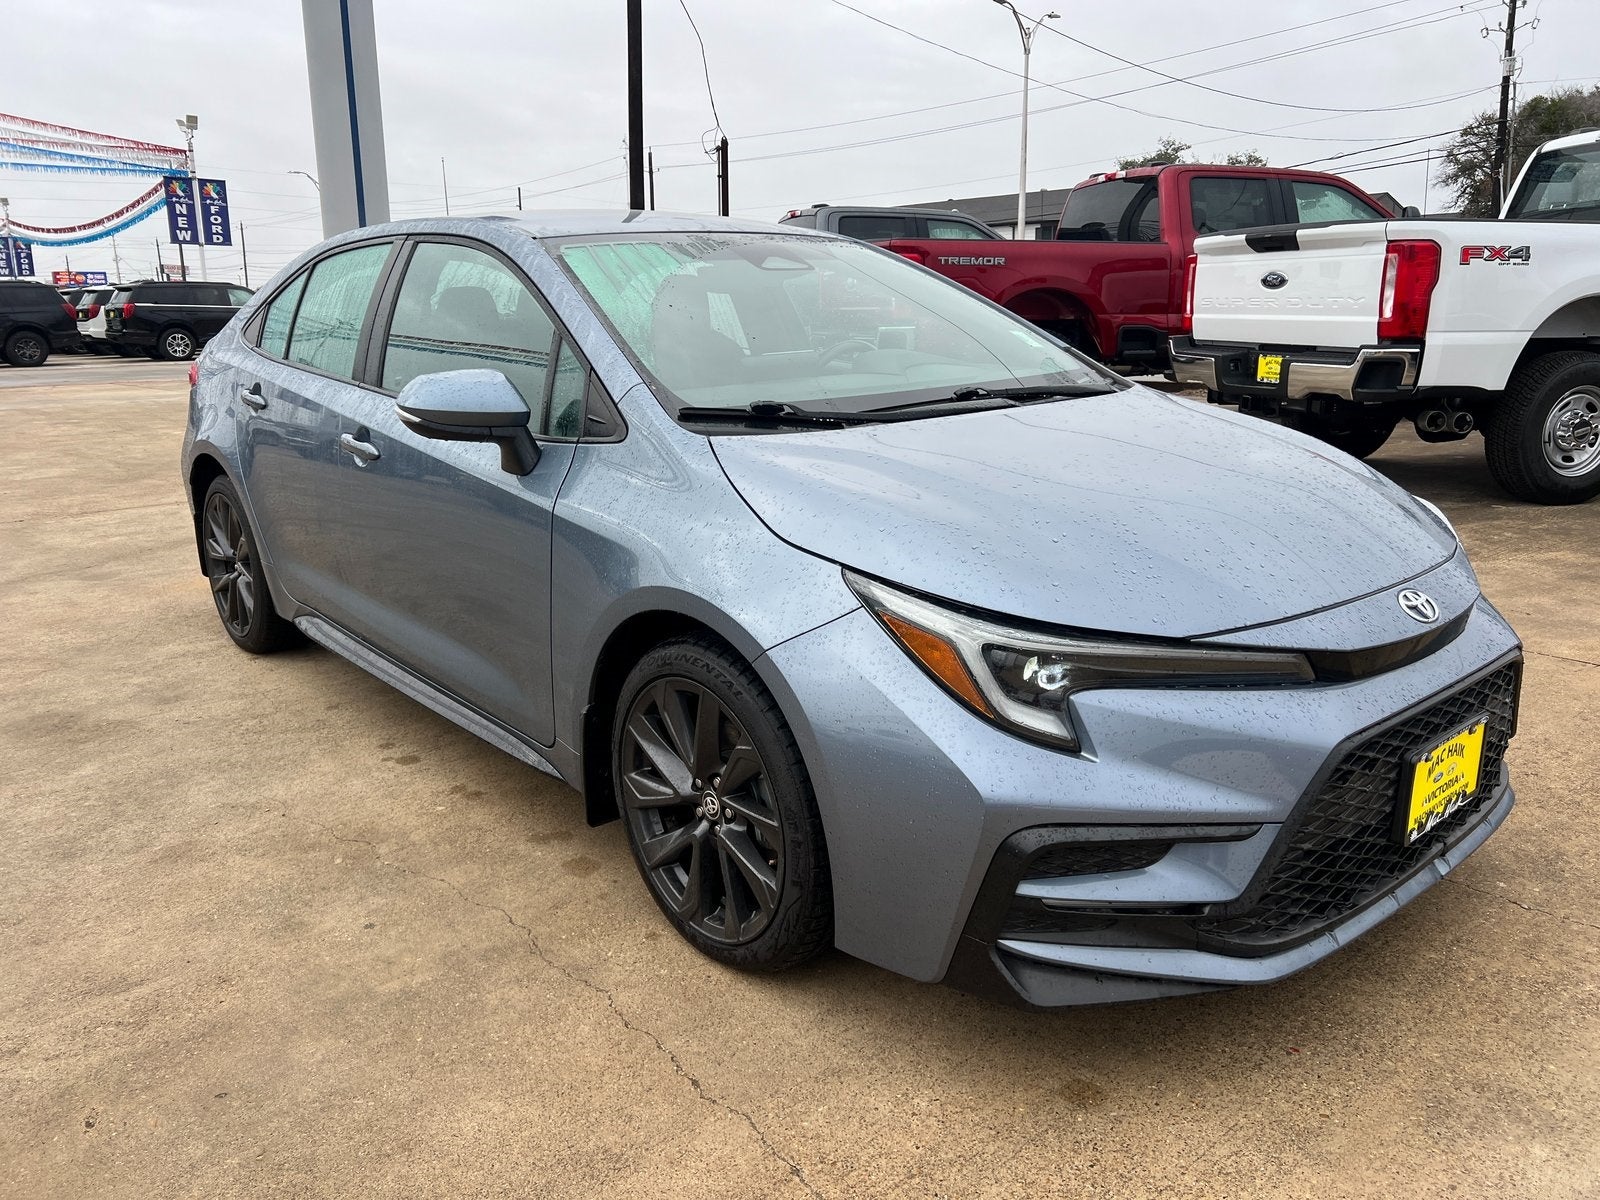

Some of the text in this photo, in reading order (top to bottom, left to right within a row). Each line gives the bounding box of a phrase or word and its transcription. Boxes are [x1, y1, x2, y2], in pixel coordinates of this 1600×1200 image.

[174, 203, 192, 241] NEW
[210, 205, 224, 243] FORD
[20, 252, 30, 275] FORD
[937, 256, 1006, 266] TREMOR
[1459, 245, 1531, 265] FX4
[1200, 296, 1366, 309] SUPER DUTY
[1426, 743, 1466, 782] MAC HAIK
